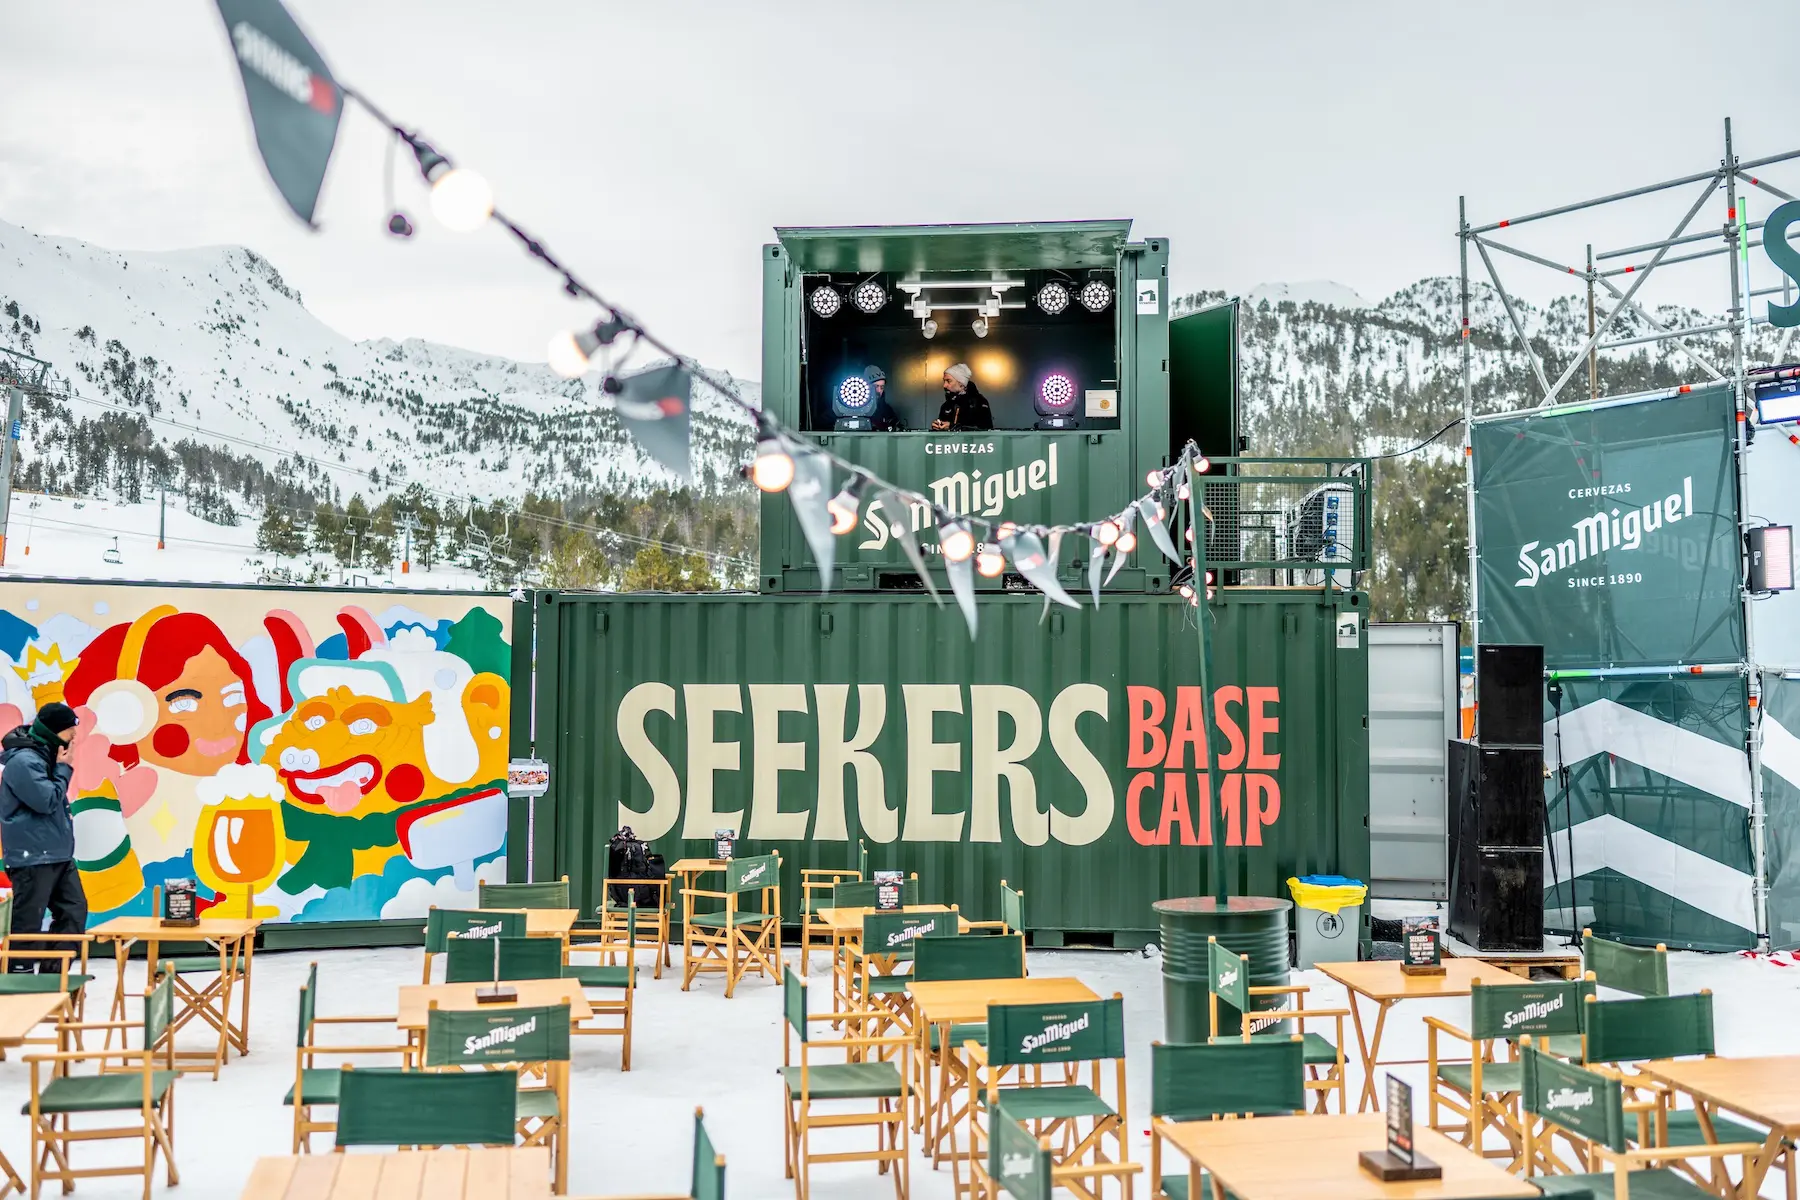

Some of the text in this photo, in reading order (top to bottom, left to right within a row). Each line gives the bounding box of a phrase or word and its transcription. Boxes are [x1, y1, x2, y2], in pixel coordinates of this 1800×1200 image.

[925, 442, 994, 454] CERVEZAS
[858, 442, 1058, 550] SnMiguel
[1568, 483, 1631, 499] CERVEZAS
[1568, 572, 1642, 588] SINCE 1890
[616, 682, 1115, 847] SEEKERS
[1126, 684, 1281, 769] BASE
[1126, 771, 1281, 847] CAMP
